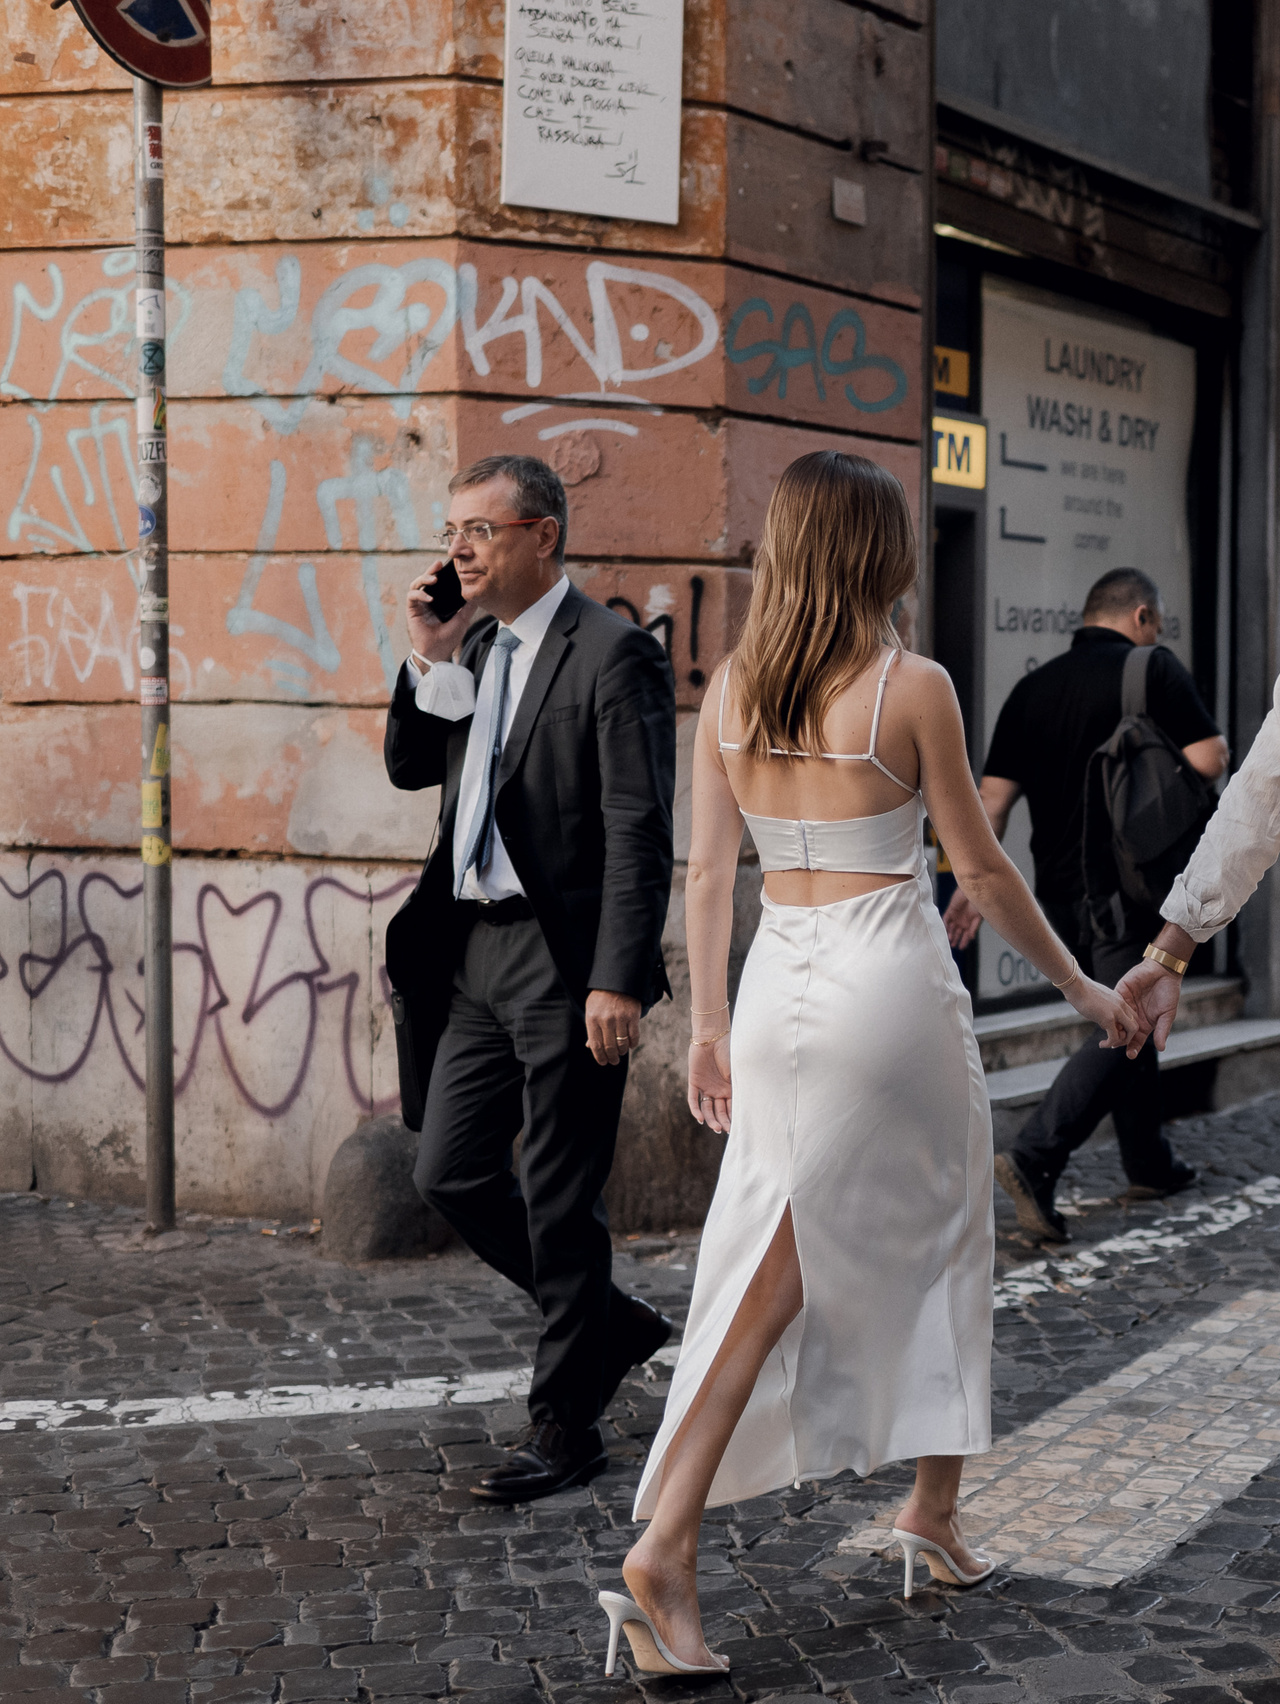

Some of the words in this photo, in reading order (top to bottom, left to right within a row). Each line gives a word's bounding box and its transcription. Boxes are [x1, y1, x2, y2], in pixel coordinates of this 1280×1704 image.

[1045, 338, 1147, 393] LAUNDRY
[1027, 394, 1092, 441] WASH
[1099, 410, 1111, 443] &
[1118, 413, 1160, 452] DRY
